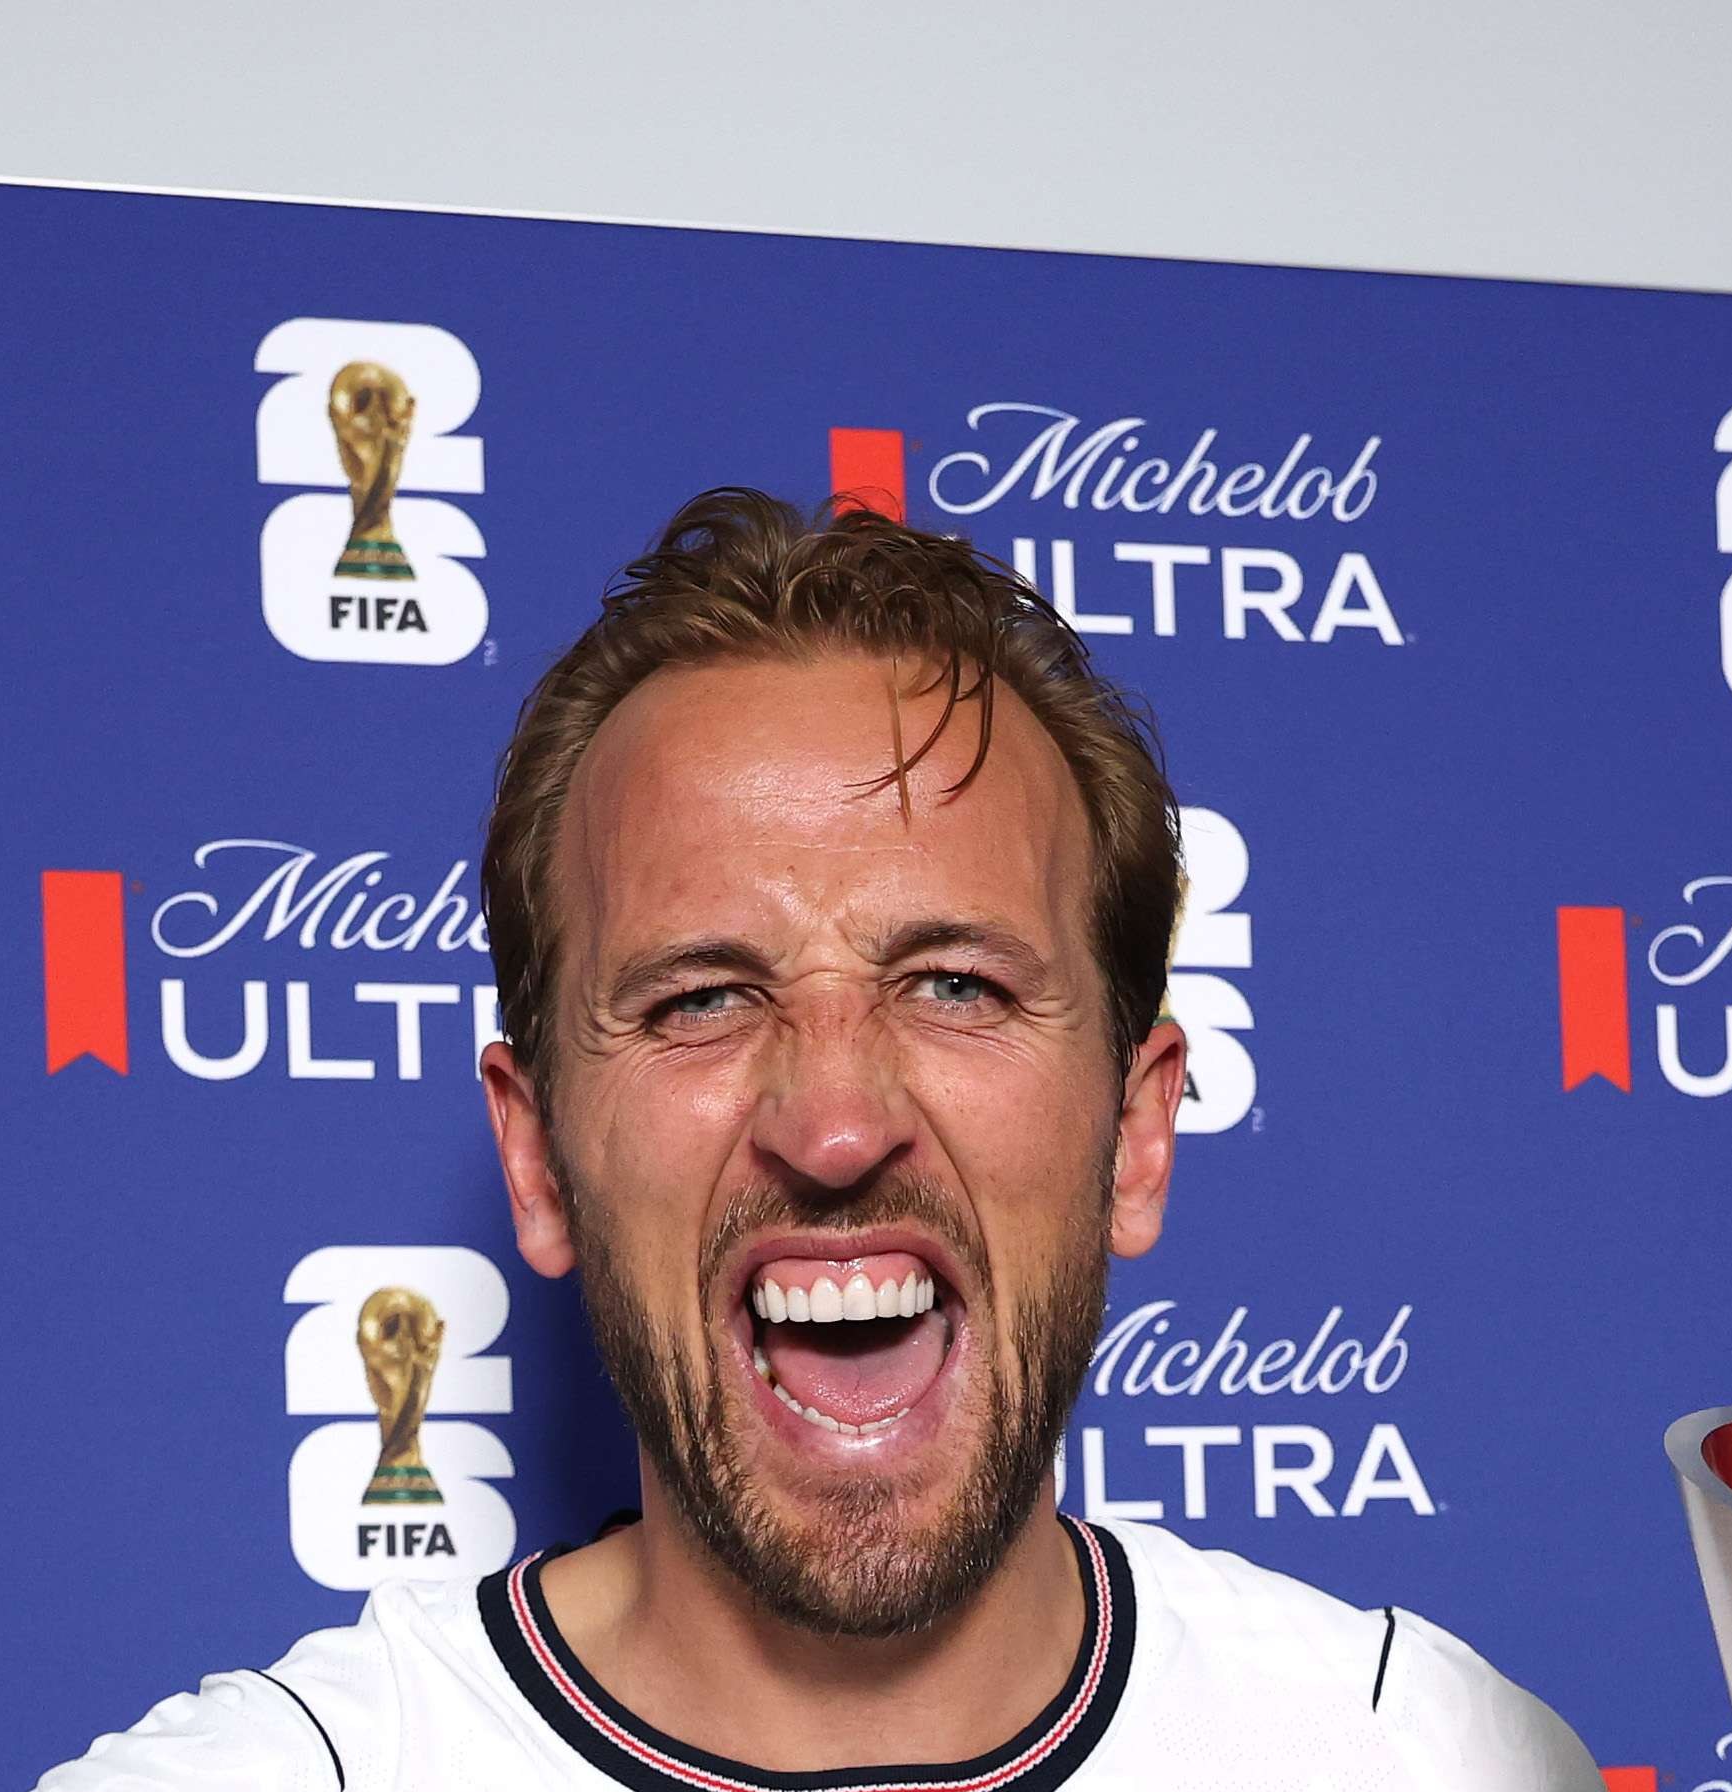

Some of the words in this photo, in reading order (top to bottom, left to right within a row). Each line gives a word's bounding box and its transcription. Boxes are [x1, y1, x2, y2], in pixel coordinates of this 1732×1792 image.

[928, 402, 1382, 523] Michelob
[330, 596, 428, 633] FIFA
[160, 978, 505, 1082] ULT
[1054, 1423, 1436, 1530] LTRA
[358, 1523, 456, 1557] FIFA
